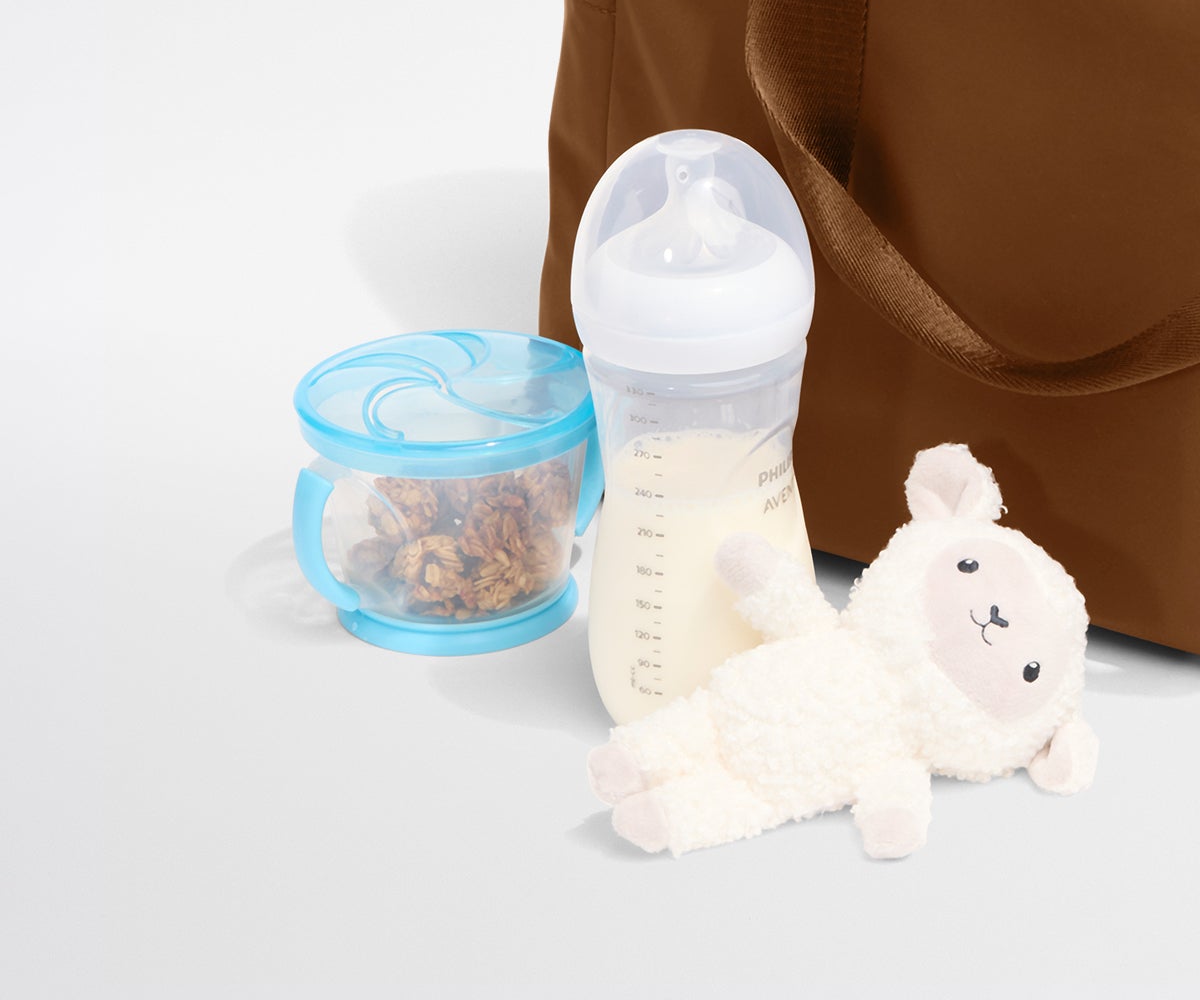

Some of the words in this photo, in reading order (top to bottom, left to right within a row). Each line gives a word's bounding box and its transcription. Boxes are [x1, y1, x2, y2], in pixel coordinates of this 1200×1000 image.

[634, 448, 650, 460] 270
[635, 486, 652, 499] 240
[637, 526, 653, 538] 210
[636, 564, 653, 577] 180
[635, 598, 651, 610] 150
[635, 629, 650, 641] 120
[637, 658, 650, 668] 90
[639, 686, 652, 696] 60
